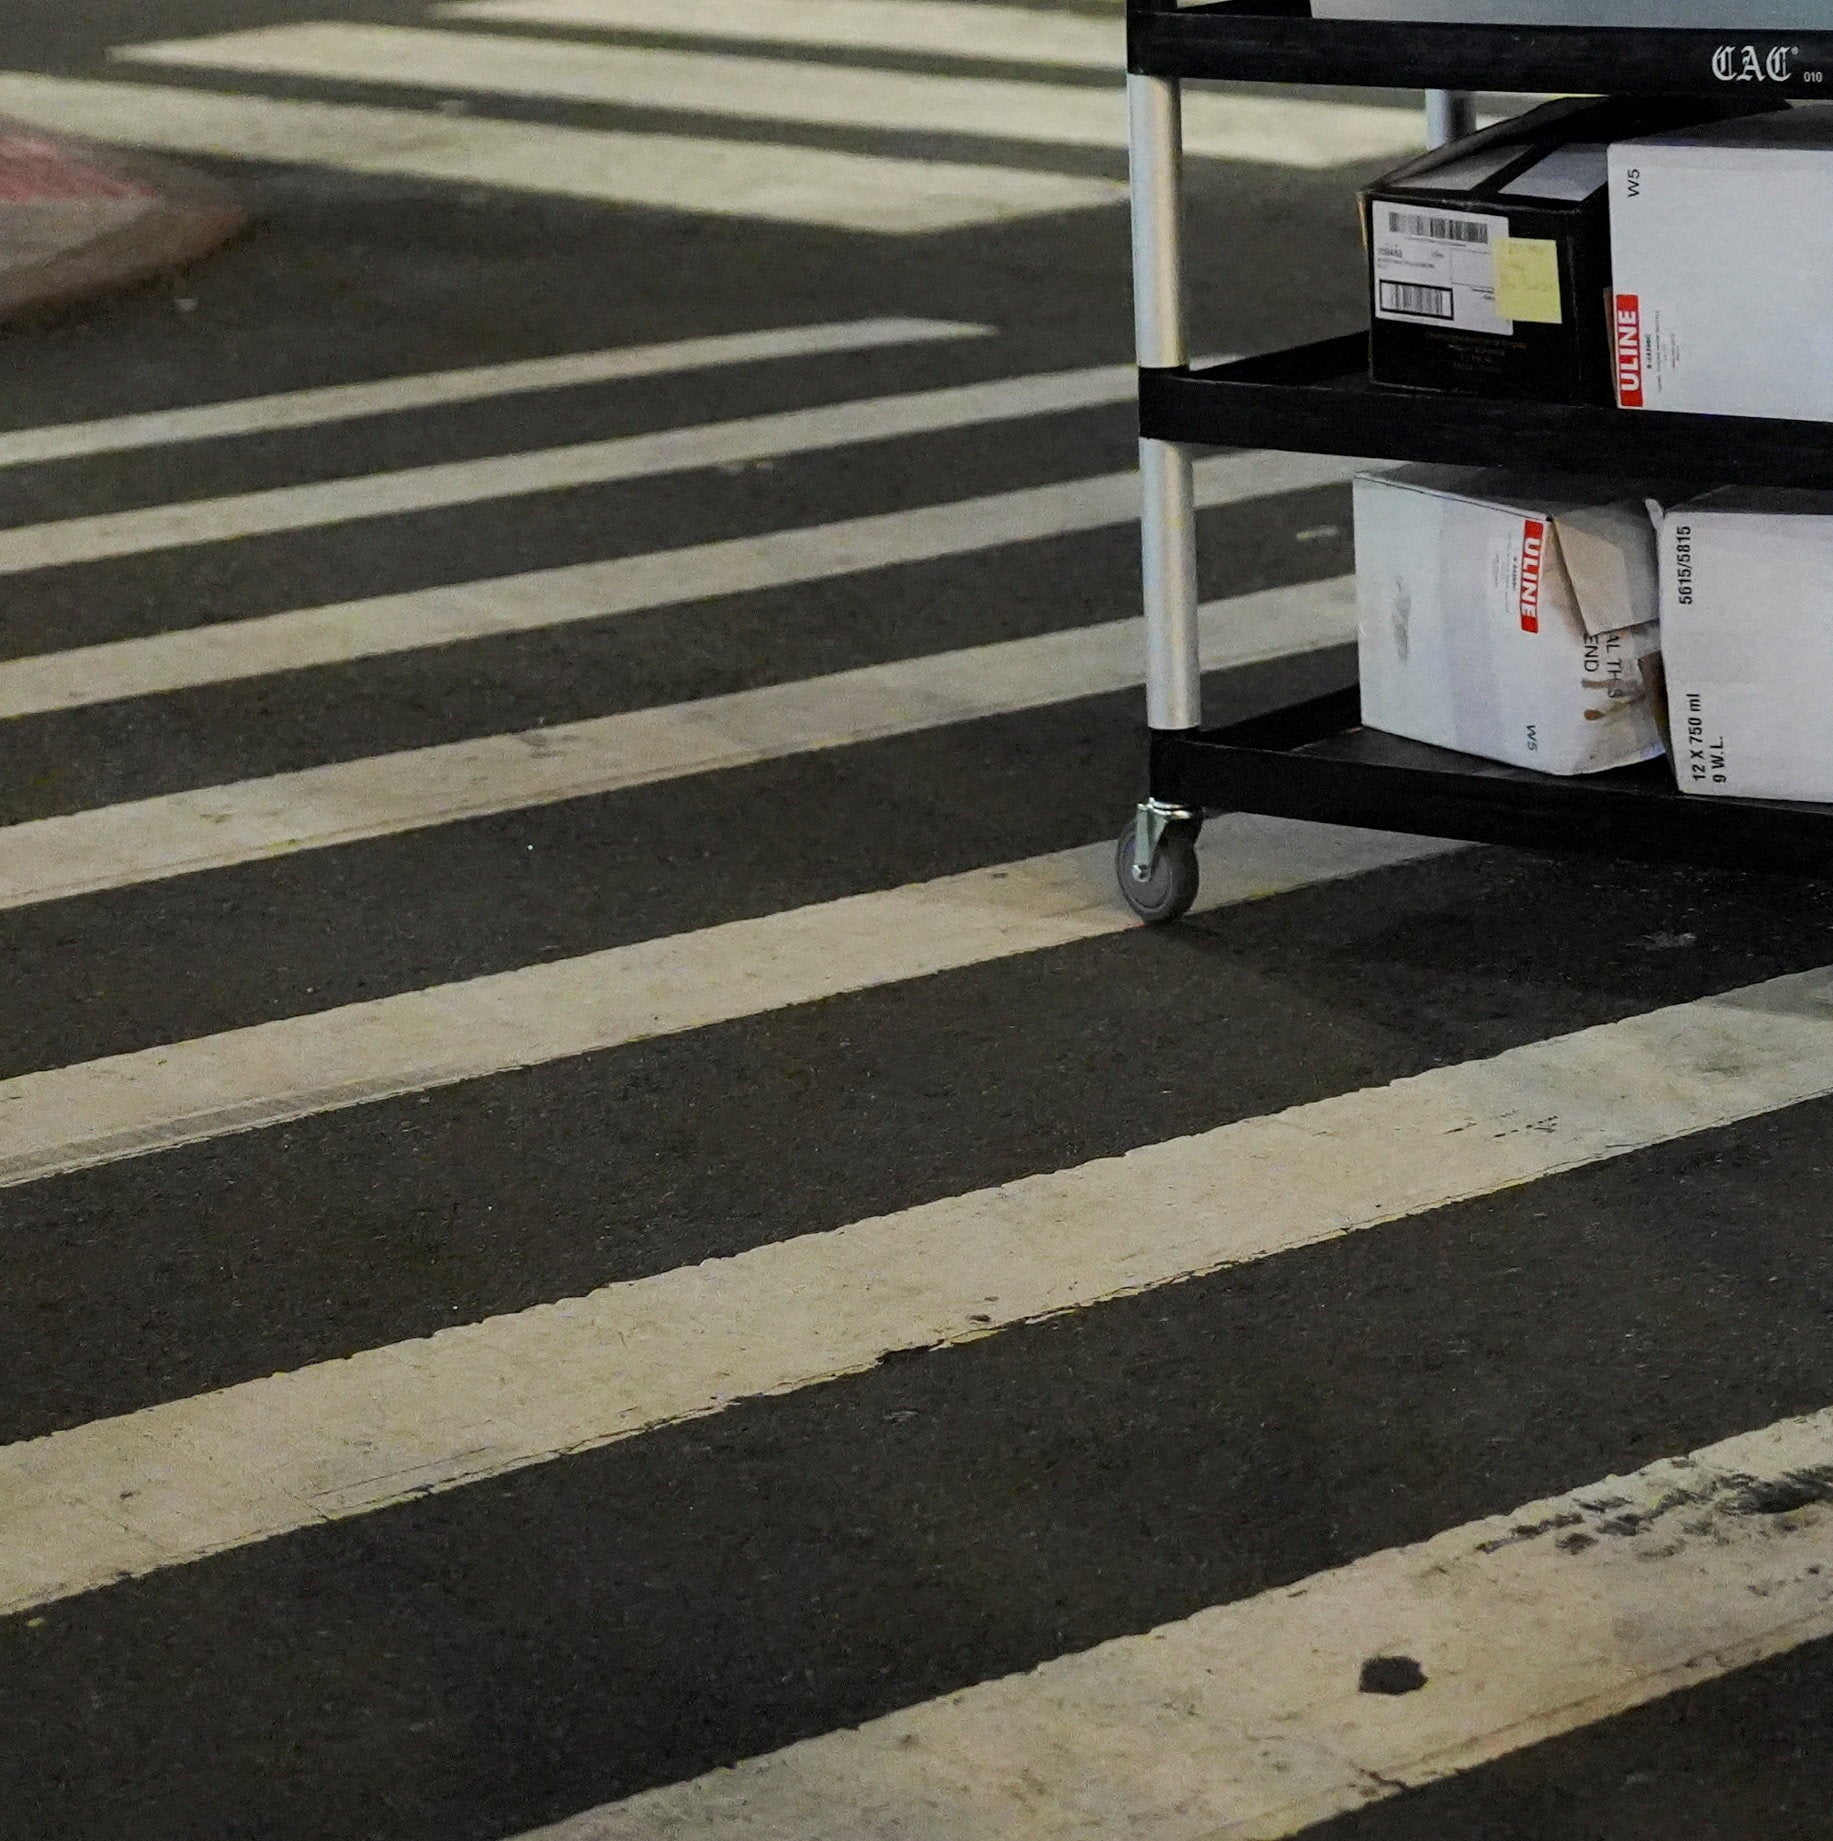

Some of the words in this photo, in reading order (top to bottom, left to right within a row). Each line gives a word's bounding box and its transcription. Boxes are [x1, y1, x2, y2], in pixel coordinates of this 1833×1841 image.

[1803, 71, 1823, 83] 010
[1627, 168, 1641, 198] W5
[1617, 310, 1640, 392] ULINE
[1520, 538, 1542, 619] ULINE
[1676, 525, 1693, 605] 5615/5815
[1583, 633, 1600, 673] END
[1606, 633, 1621, 654] AL
[1607, 659, 1624, 699] THS
[1686, 693, 1700, 710] ml
[1688, 717, 1703, 746] 750
[1710, 736, 1725, 771] W.L.
[1692, 764, 1706, 782] 12
[1713, 773, 1727, 784] 9
